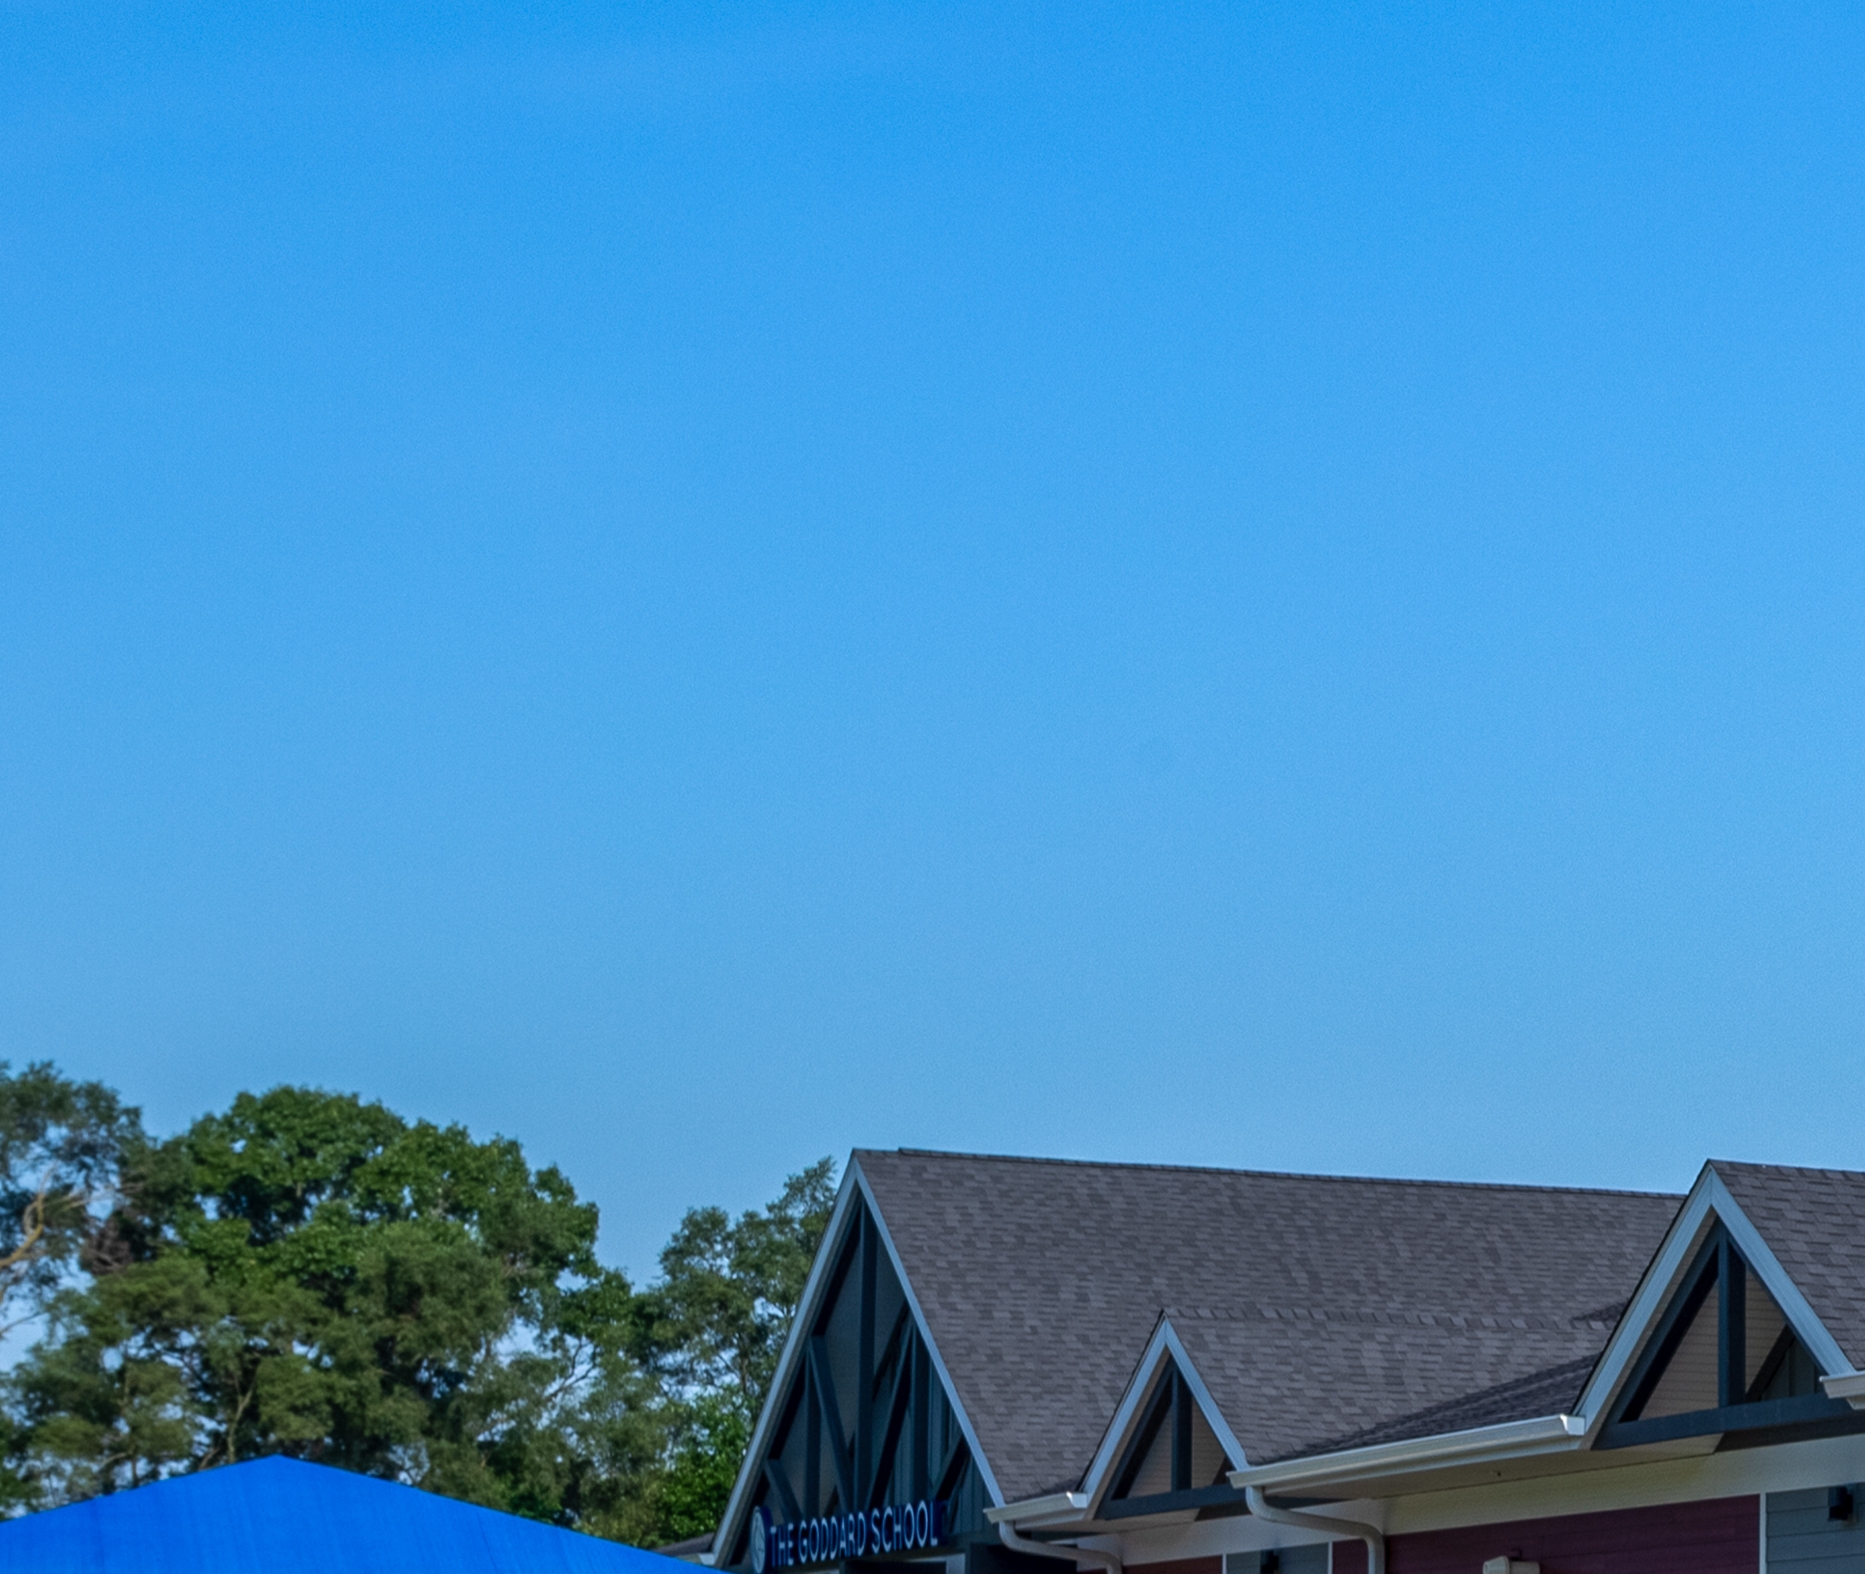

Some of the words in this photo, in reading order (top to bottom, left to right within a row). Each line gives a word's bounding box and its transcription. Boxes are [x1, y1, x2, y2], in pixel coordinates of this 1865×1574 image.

[770, 1522, 794, 1567] THE
[798, 1511, 867, 1564] GODDARD
[871, 1499, 938, 1554] SCHOOL
